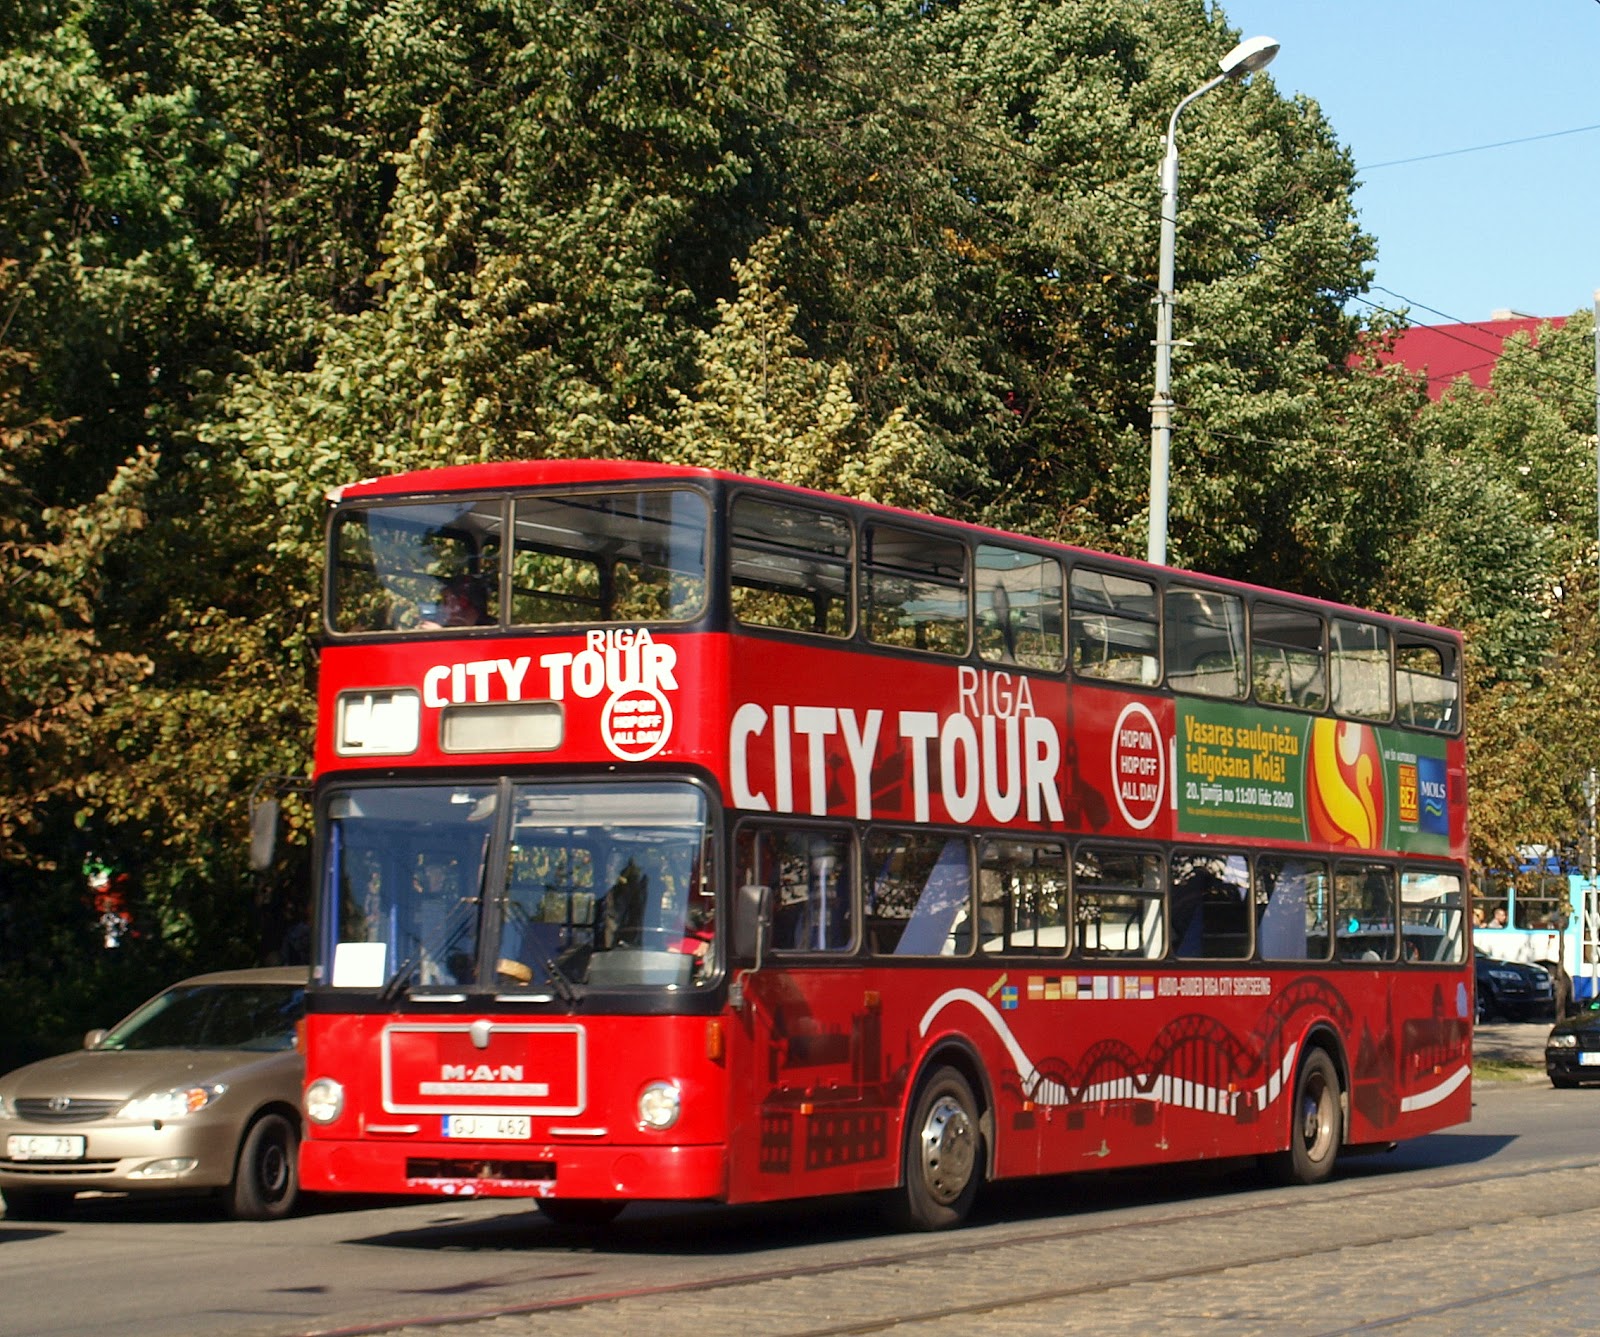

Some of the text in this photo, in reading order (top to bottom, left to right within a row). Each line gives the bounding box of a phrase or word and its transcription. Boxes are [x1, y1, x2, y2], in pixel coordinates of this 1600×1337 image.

[587, 628, 654, 653] RIGA
[424, 643, 679, 708] CITY TOUR
[957, 665, 1036, 719] RIGA
[613, 731, 636, 744] ALL
[1120, 729, 1152, 750] HOP ON
[1185, 715, 1299, 758] Vasaras saulgriežu
[729, 702, 1064, 824] CITY TOUR
[1121, 755, 1157, 776] HOP OFF
[1122, 781, 1157, 802] ALL DAY
[1186, 782, 1200, 799] 20.
[1421, 781, 1446, 799] MOLS
